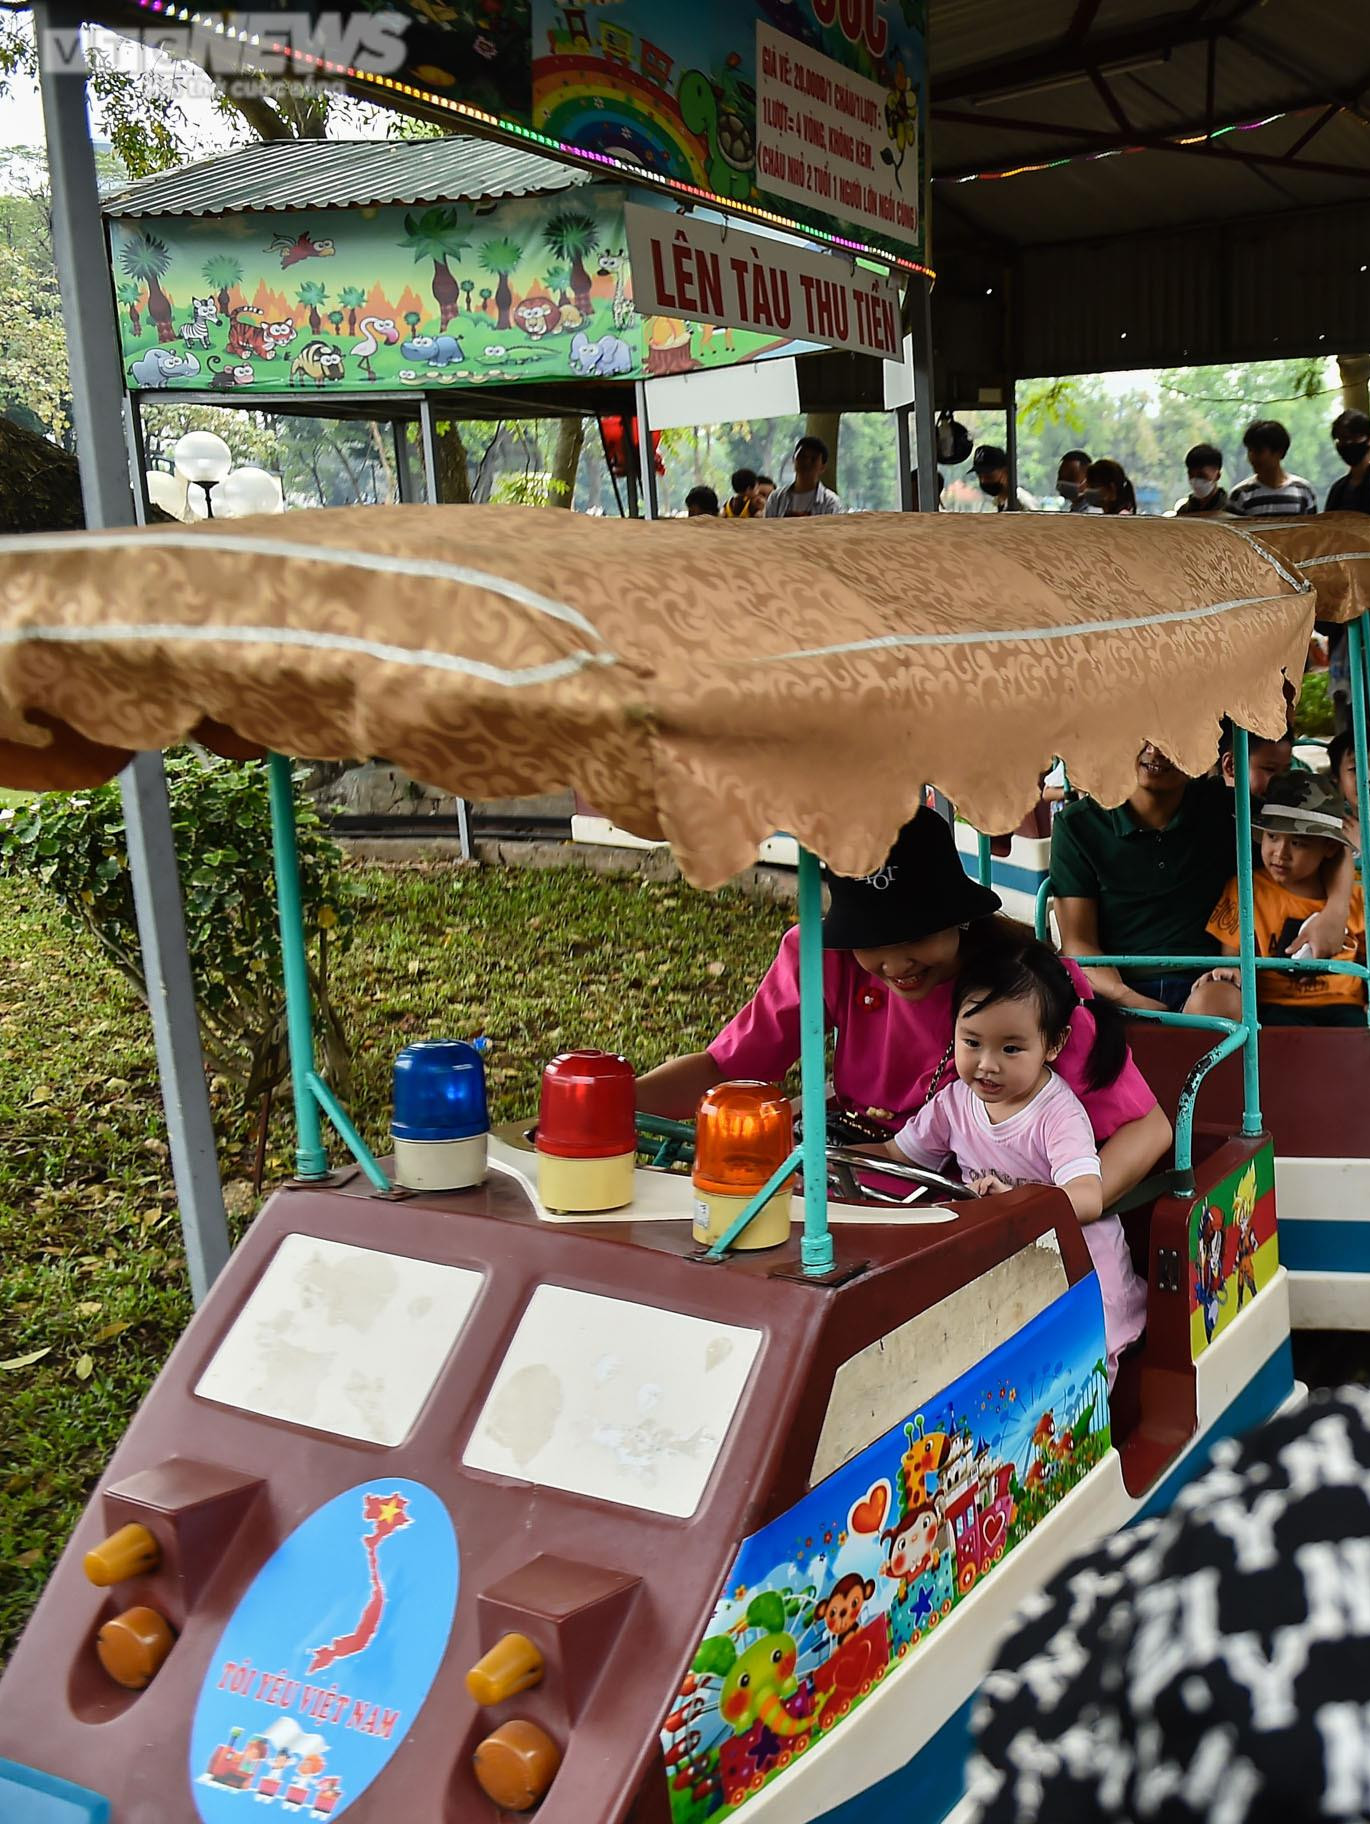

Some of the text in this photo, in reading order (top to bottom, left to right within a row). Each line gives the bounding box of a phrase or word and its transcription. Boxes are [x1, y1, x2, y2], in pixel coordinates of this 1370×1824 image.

[807, 167, 813, 191] 2
[650, 229, 897, 354] LÊN TÀU THU TIỀN
[217, 1659, 401, 1740] TÔI YÊU VIỆT NAM
